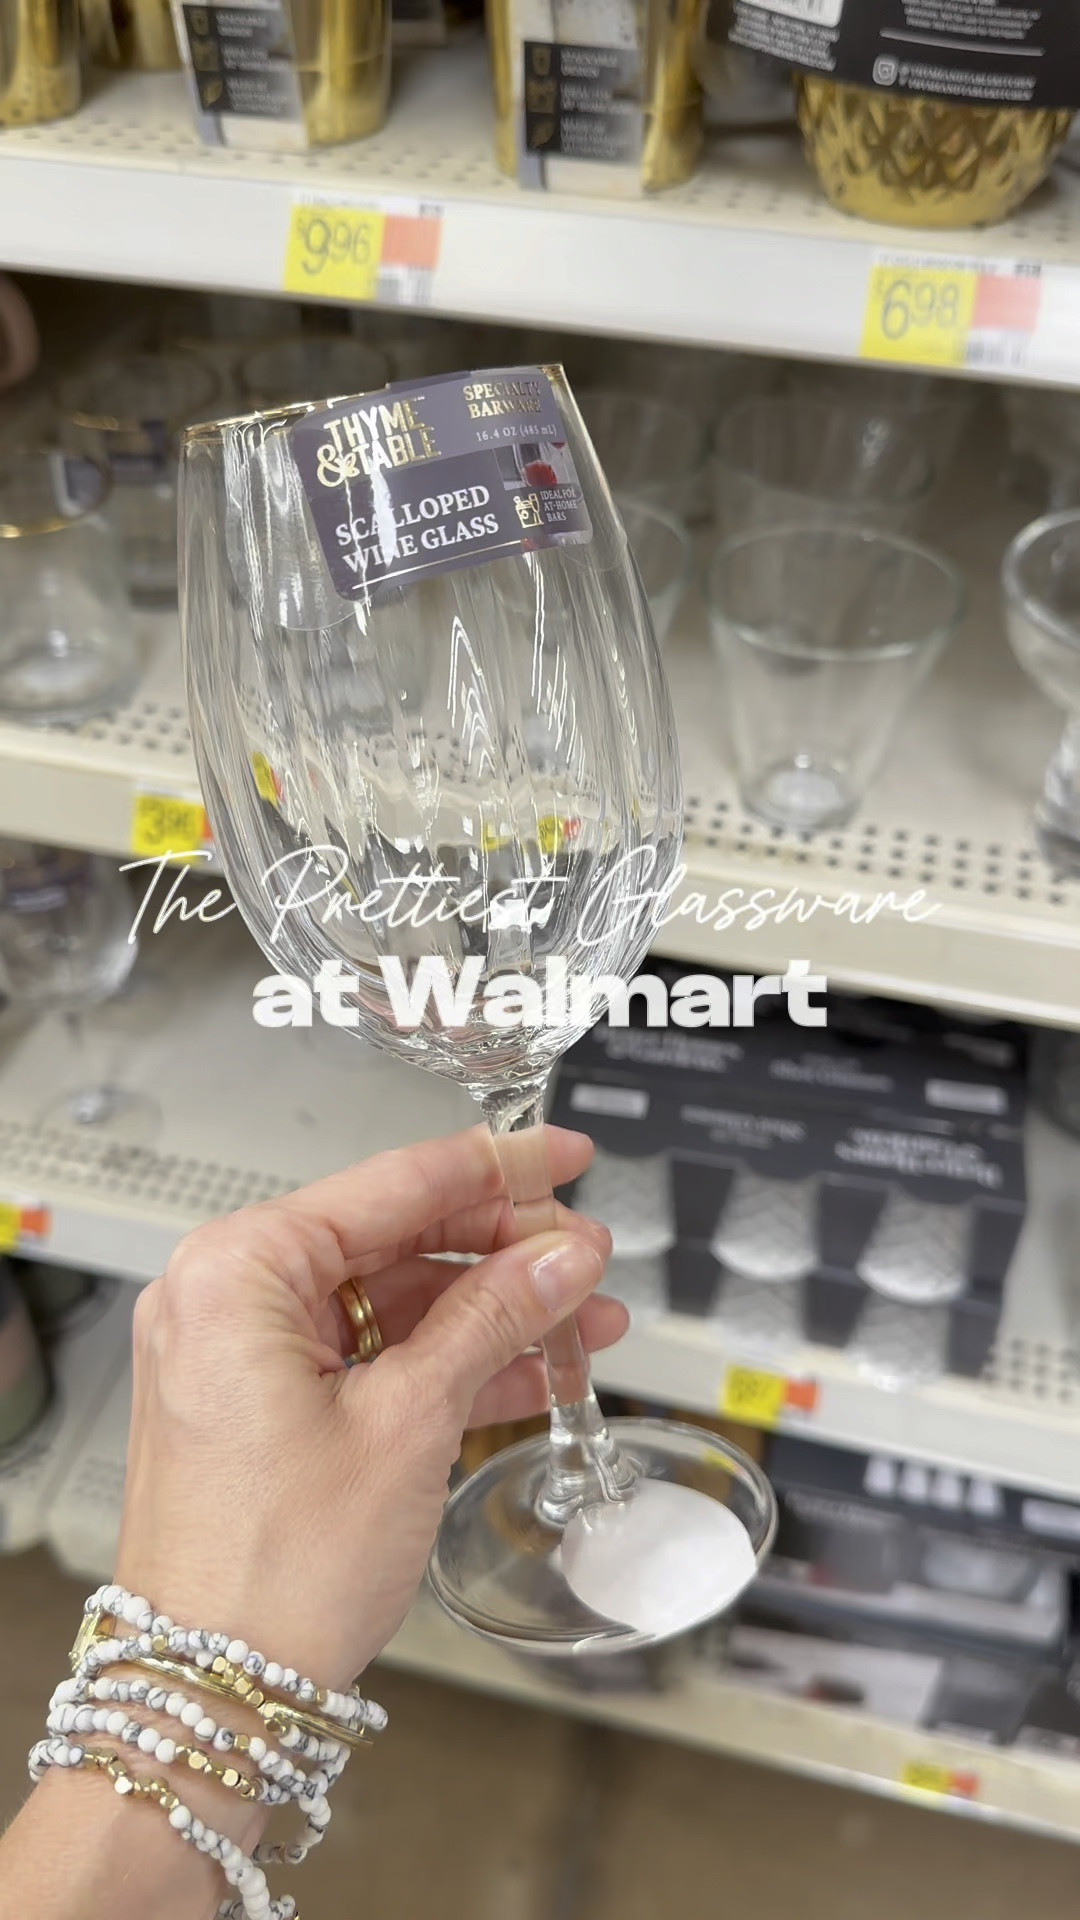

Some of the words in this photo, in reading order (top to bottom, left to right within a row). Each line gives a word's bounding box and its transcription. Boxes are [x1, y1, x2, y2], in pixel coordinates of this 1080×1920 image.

[463, 381, 542, 402] SPECIALTY
[467, 398, 543, 420] BARWARE
[323, 396, 426, 450] THYME
[476, 428, 500, 442] 16.4
[502, 426, 518, 438] OZ
[540, 489, 563, 502] IDEAL
[562, 487, 578, 500] FOR
[543, 499, 578, 512] AT-HOME
[546, 511, 568, 523] BARS
[420, 513, 500, 550] GLASS
